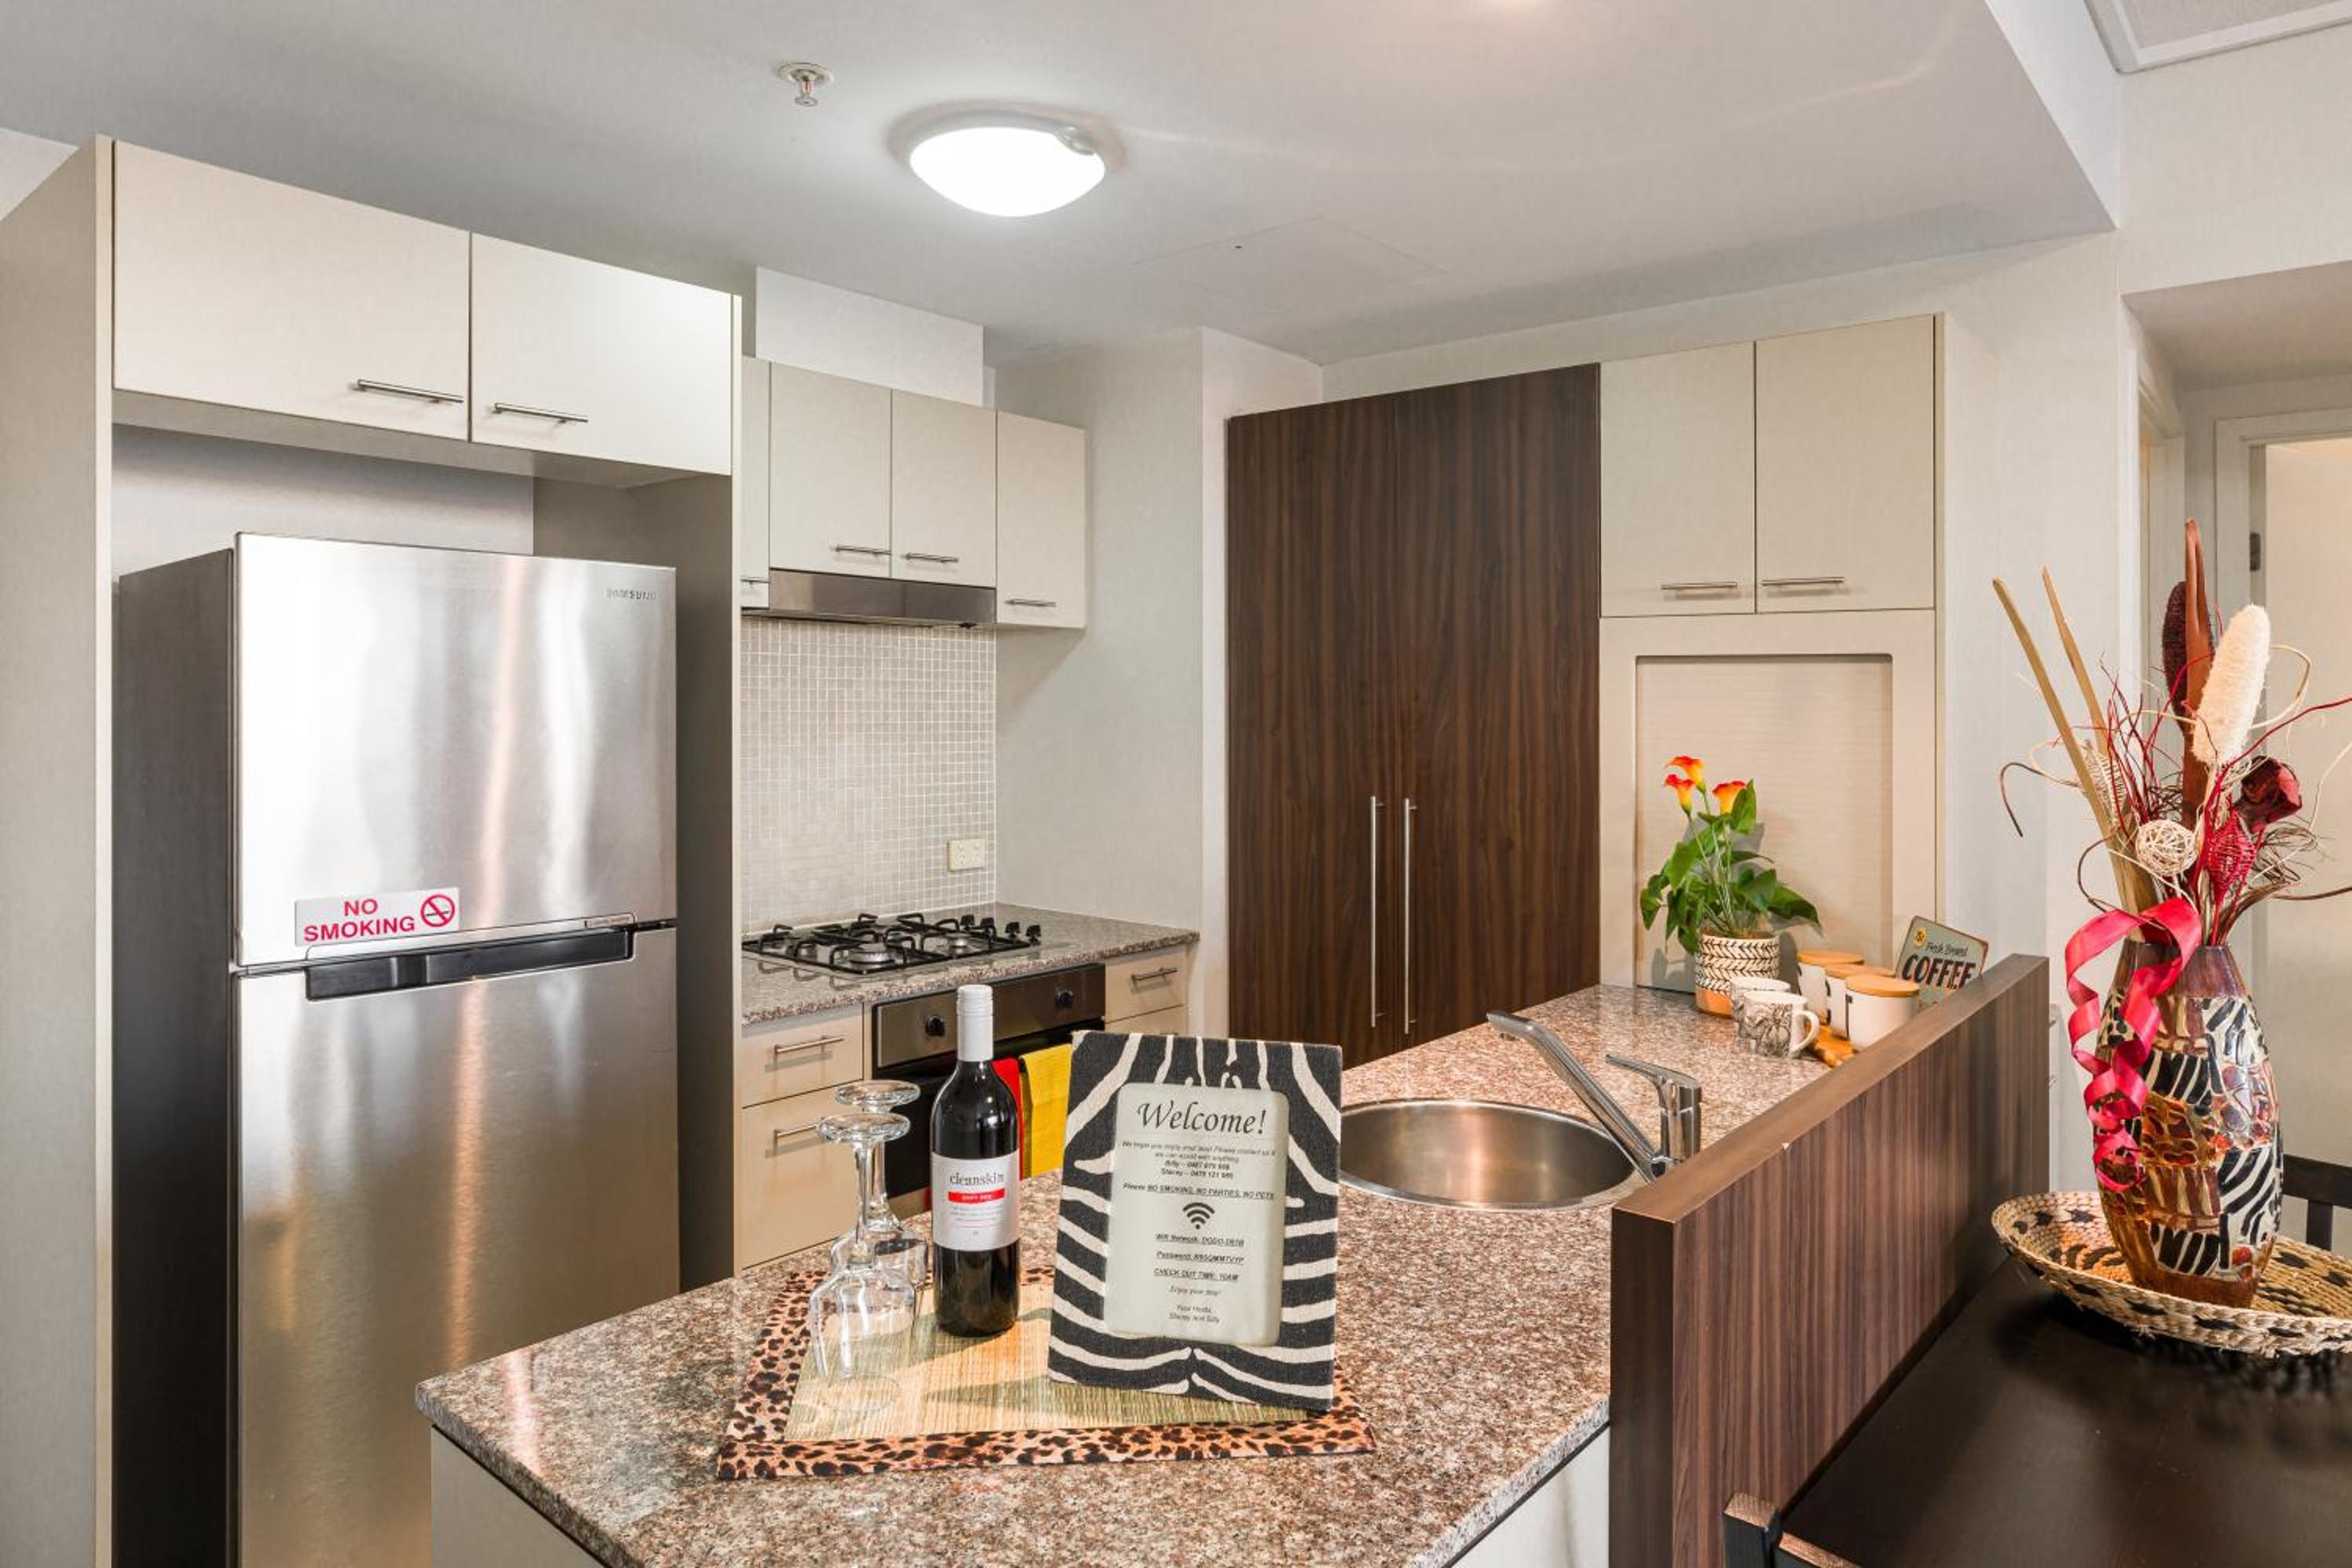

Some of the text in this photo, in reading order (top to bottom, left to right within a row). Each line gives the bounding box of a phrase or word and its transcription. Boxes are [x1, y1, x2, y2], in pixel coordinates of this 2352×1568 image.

[343, 898, 379, 917] NO
[303, 915, 416, 942] SMOKING
[1901, 953, 1976, 990] COFFEE
[1137, 1099, 1267, 1134] Welcome!
[949, 1172, 1004, 1186] cleanskin
